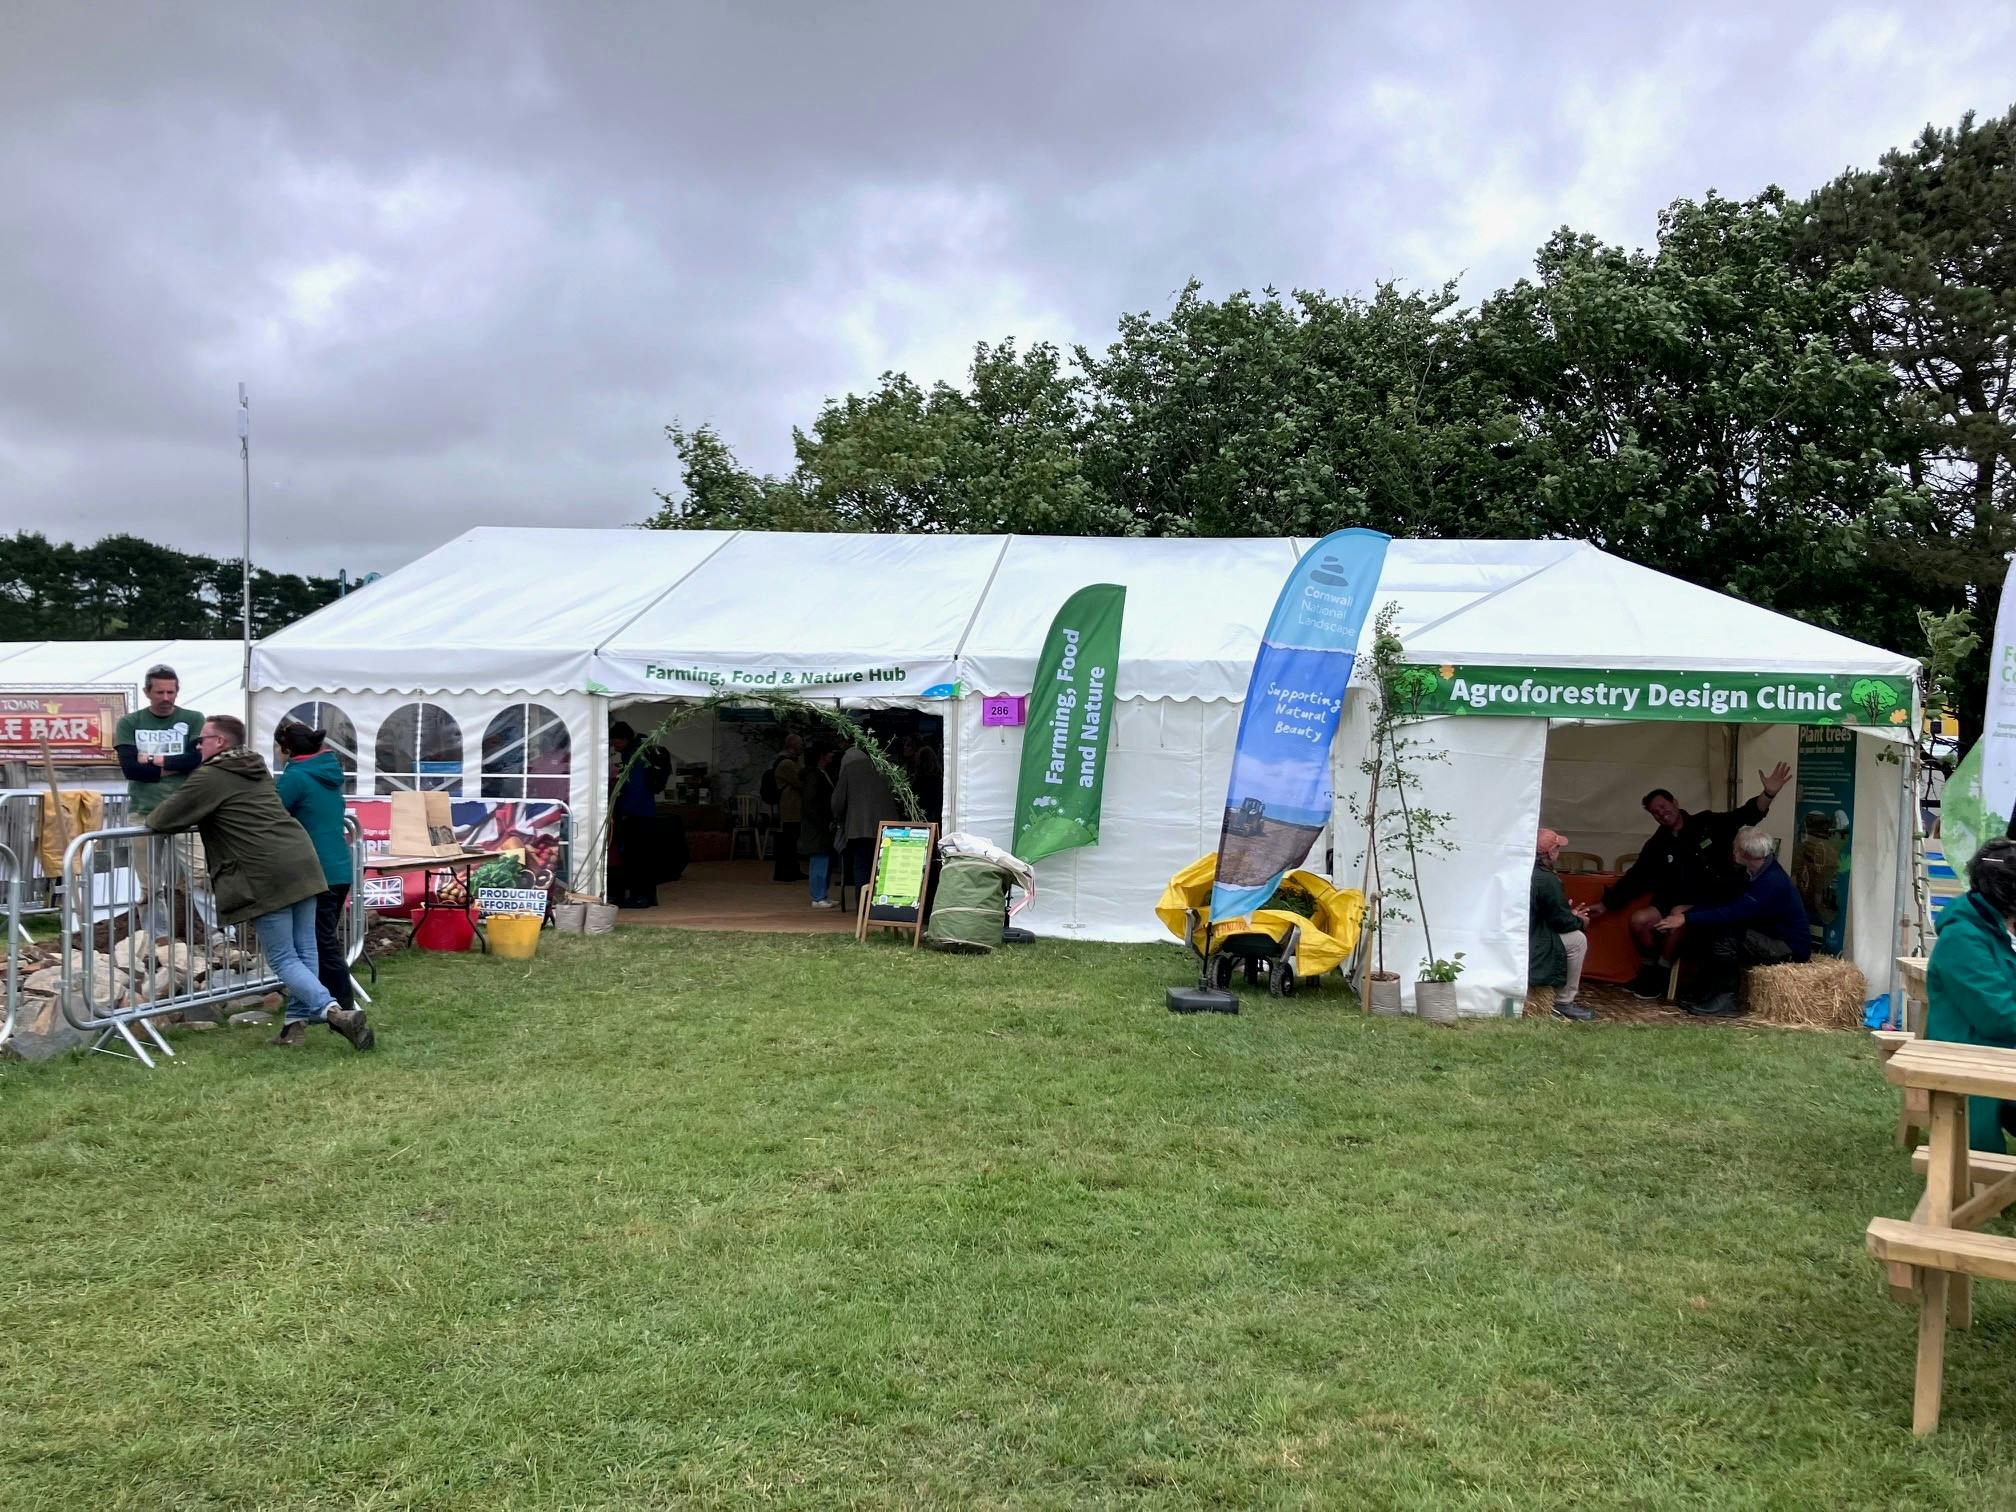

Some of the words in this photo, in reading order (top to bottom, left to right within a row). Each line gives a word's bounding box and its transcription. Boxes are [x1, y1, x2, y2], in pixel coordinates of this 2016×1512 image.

[1304, 585, 1353, 607] Cornwall
[1301, 599, 1346, 620] National
[1298, 612, 1355, 637] Landscape
[1056, 628, 1080, 682] Food
[2004, 645, 2016, 661] F
[645, 664, 725, 686] Farming,
[732, 671, 777, 684] Food
[781, 671, 796, 684] &
[800, 672, 863, 684] Nature
[868, 666, 906, 682] Hub
[1080, 666, 1105, 741] Nature
[1267, 681, 1341, 713] Supporting
[1450, 678, 1640, 711] Agroforestry
[1648, 682, 1748, 714] Design
[1756, 685, 1842, 711] Clinic
[991, 706, 1009, 715] 286
[1275, 703, 1326, 724] Natural
[30, 718, 89, 740] BAR
[137, 731, 179, 742] CREST
[1045, 688, 1077, 784] Farming,
[1274, 720, 1322, 743] Beauty
[1800, 725, 1824, 742] Plant
[1826, 725, 1852, 741] trees
[1078, 746, 1096, 788] and
[480, 889, 545, 900] PRODUCING
